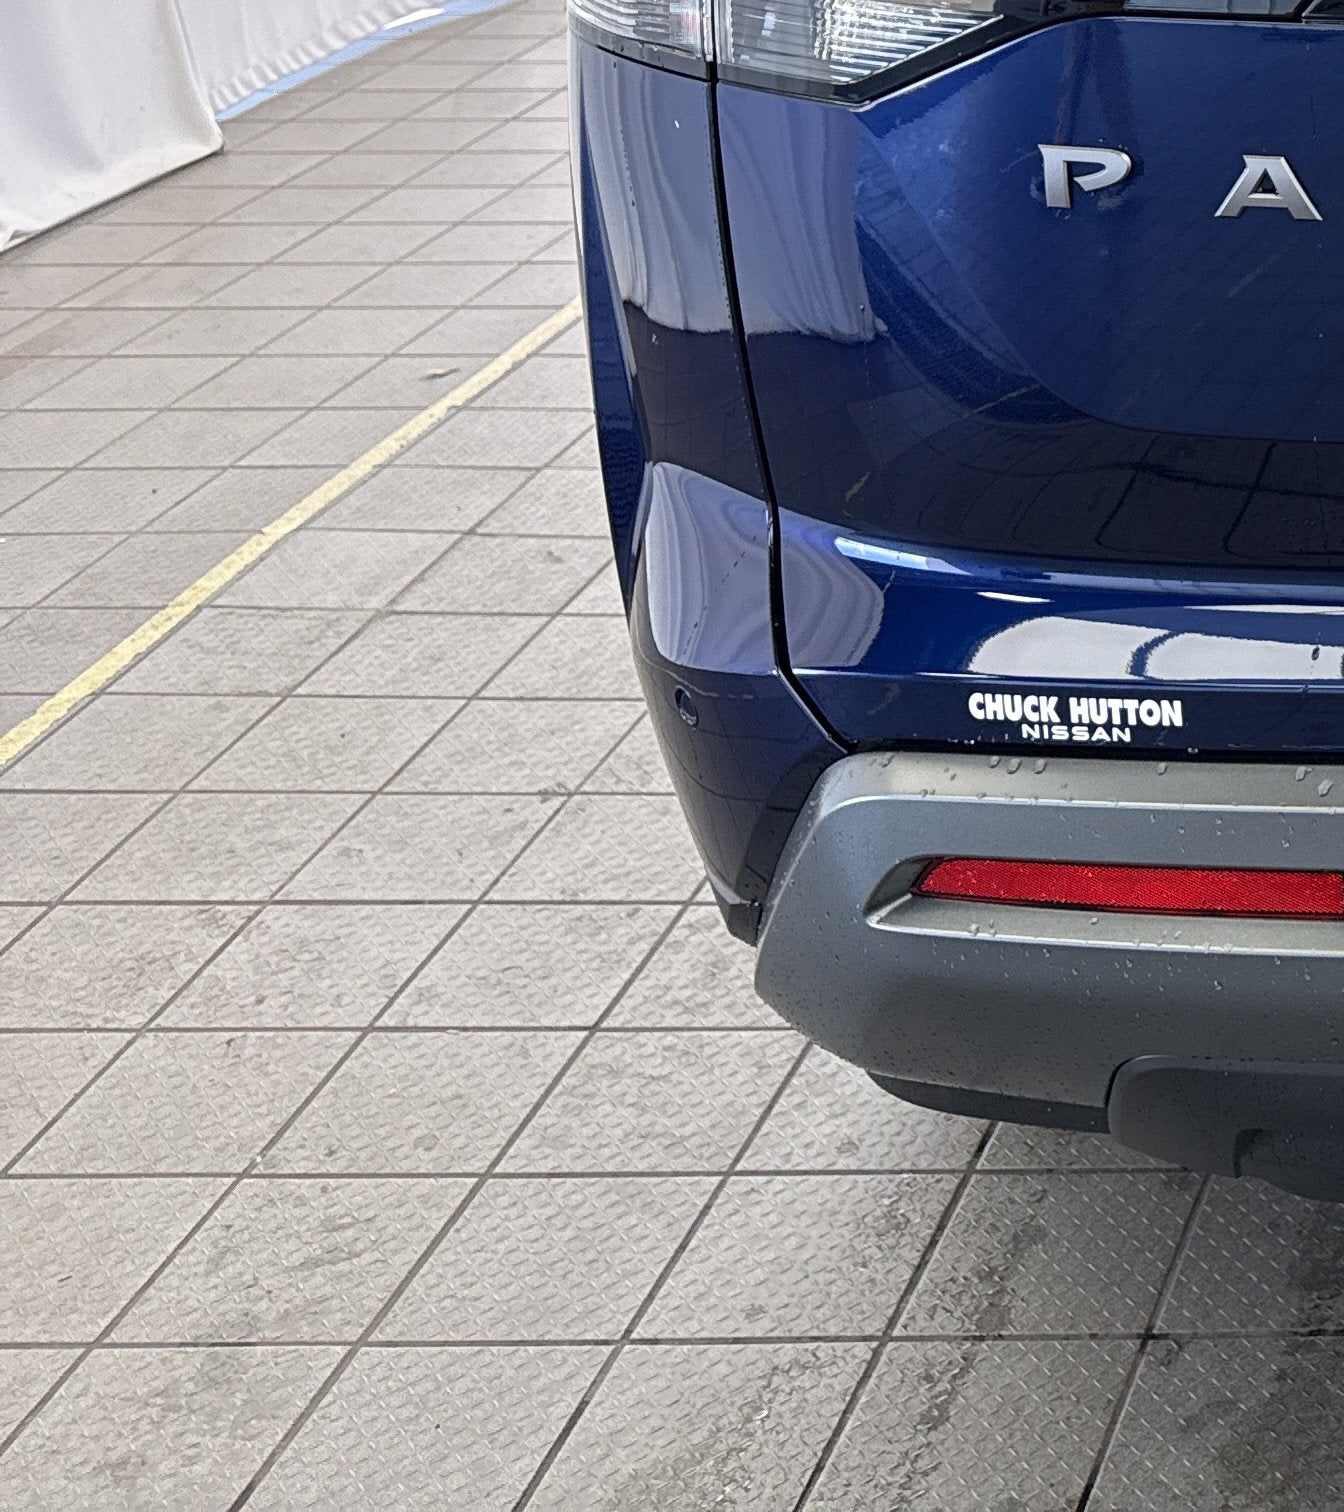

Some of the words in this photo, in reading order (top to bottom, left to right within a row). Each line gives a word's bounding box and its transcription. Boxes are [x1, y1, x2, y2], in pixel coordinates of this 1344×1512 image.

[967, 691, 1061, 724] CHUCK
[1068, 696, 1183, 727] HUTTON
[1020, 722, 1132, 743] NISSAN
